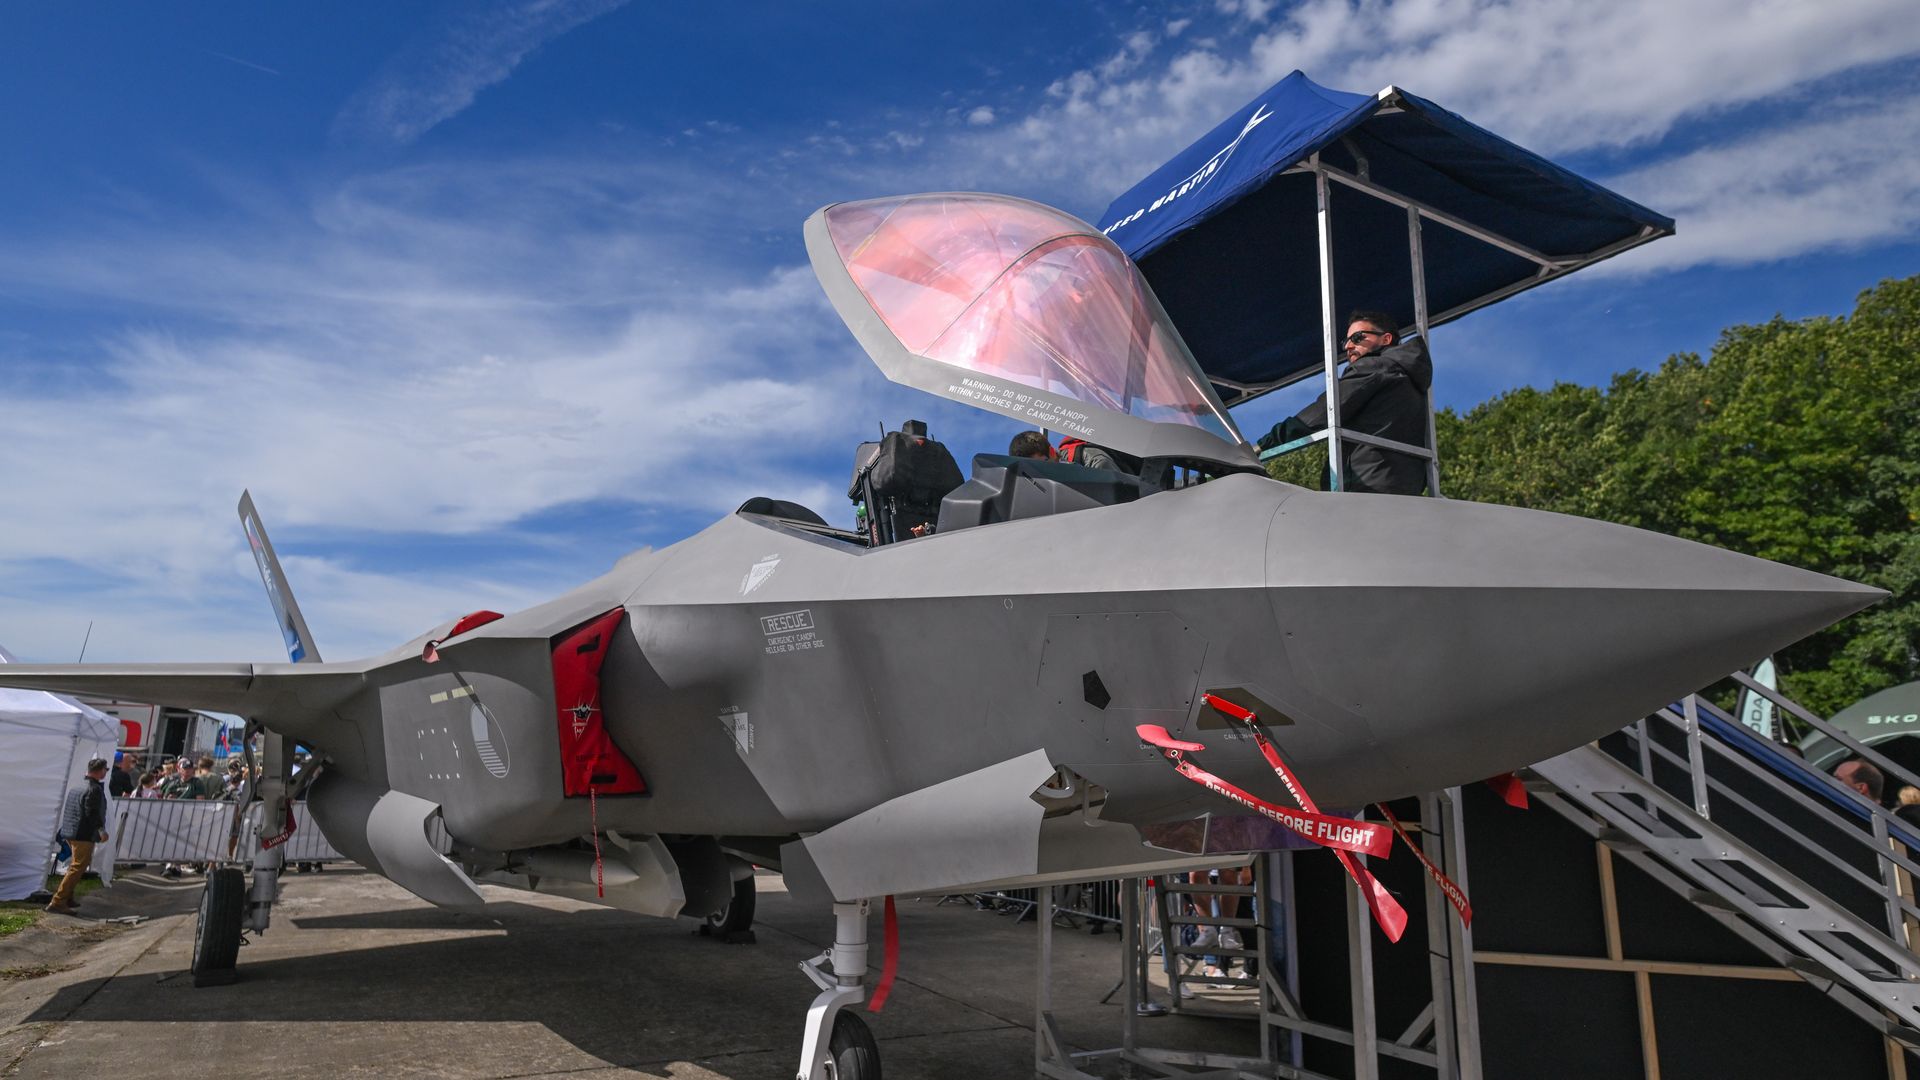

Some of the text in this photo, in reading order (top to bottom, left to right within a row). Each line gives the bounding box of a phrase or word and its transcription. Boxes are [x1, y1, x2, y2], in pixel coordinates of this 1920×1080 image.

[1148, 159, 1219, 213] MARTIN
[948, 384, 1095, 436] WITHIN 3 INCHES OF CANOPY FRAME
[962, 377, 996, 393] WARNING
[1002, 389, 1014, 399] DO
[1015, 393, 1032, 404] NOT
[1034, 399, 1052, 411] CUT
[1053, 406, 1088, 423] CANOPY
[767, 613, 807, 632] RESCUE
[1867, 714, 1919, 725] SKO
[1317, 821, 1375, 847] FLIGHT
[1434, 871, 1467, 912] FLIGHT
